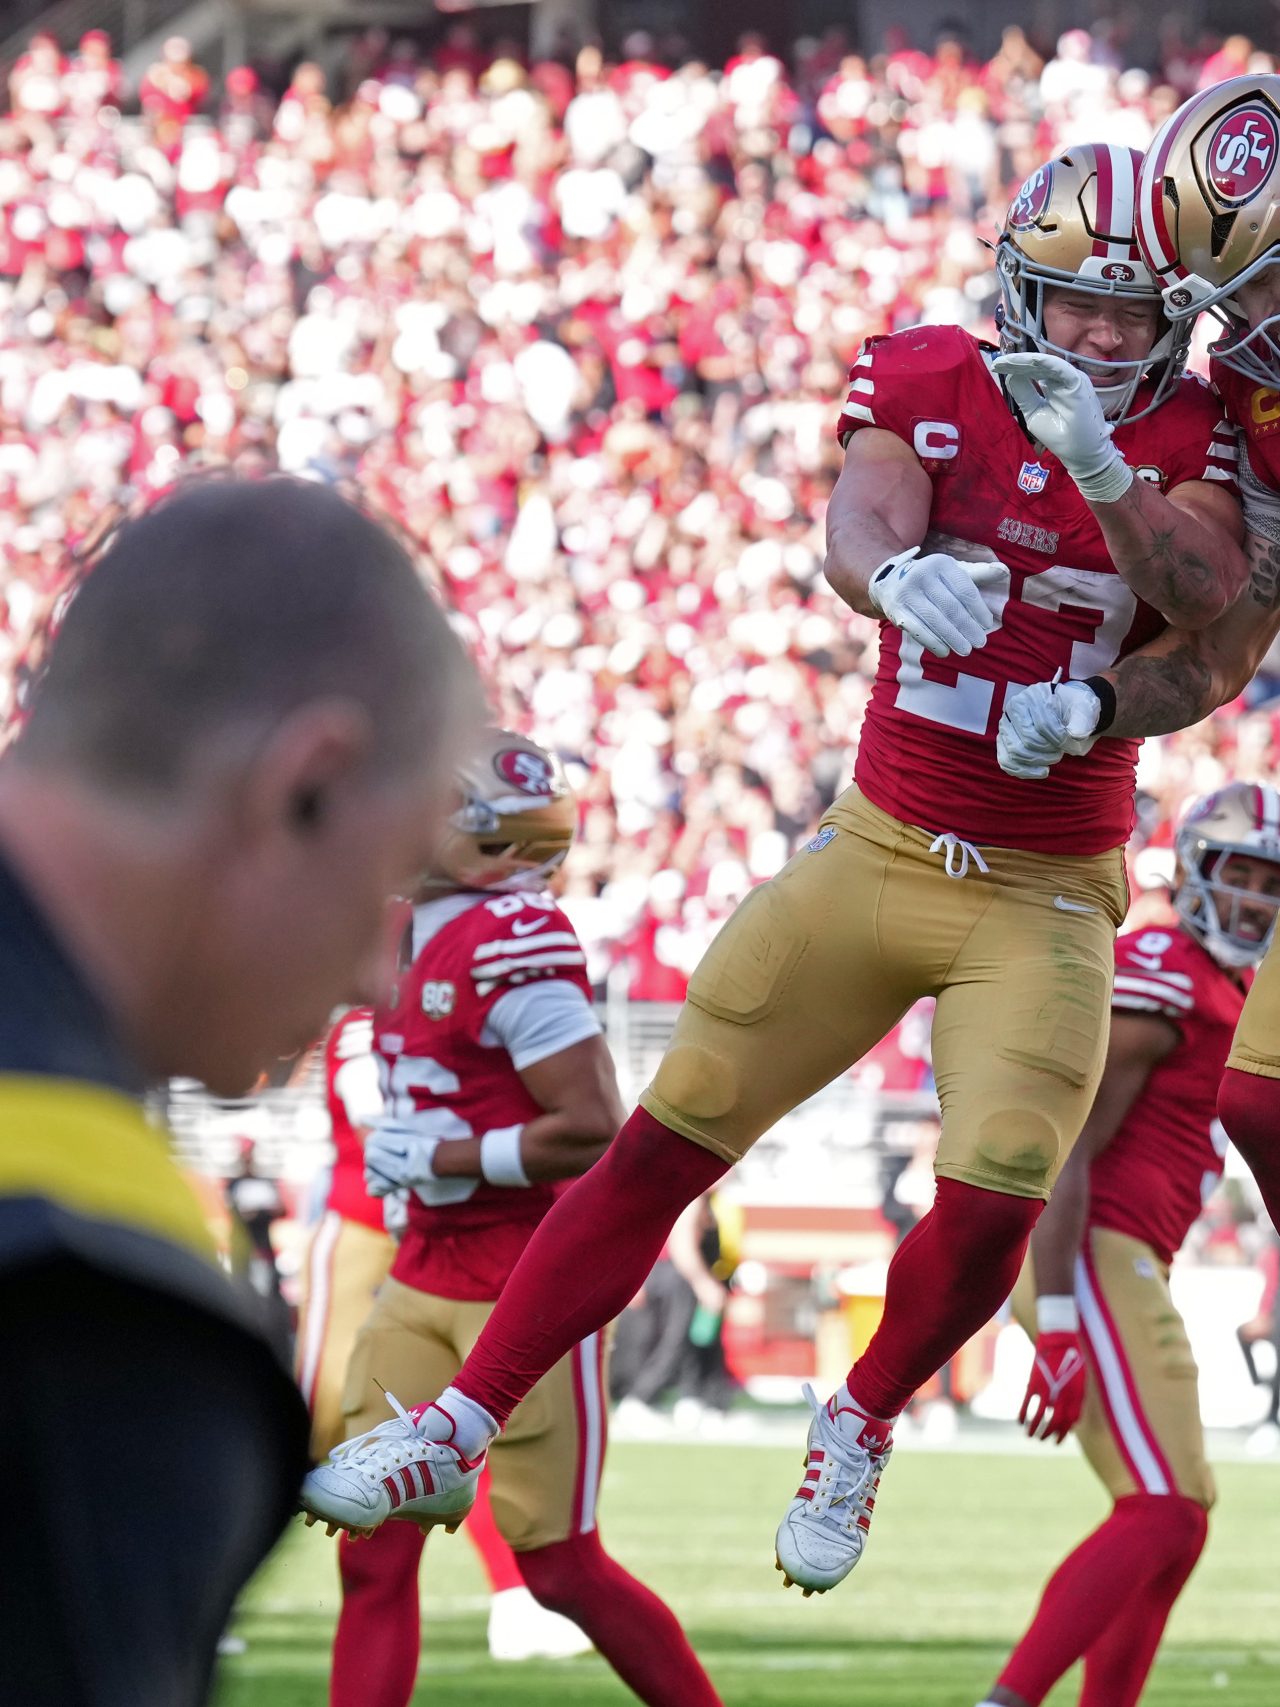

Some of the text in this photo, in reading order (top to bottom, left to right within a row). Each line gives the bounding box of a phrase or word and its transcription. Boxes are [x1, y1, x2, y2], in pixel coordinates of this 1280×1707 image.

[913, 421, 959, 460] C
[1021, 473, 1044, 489] NFL
[996, 516, 1060, 555] 49ERS
